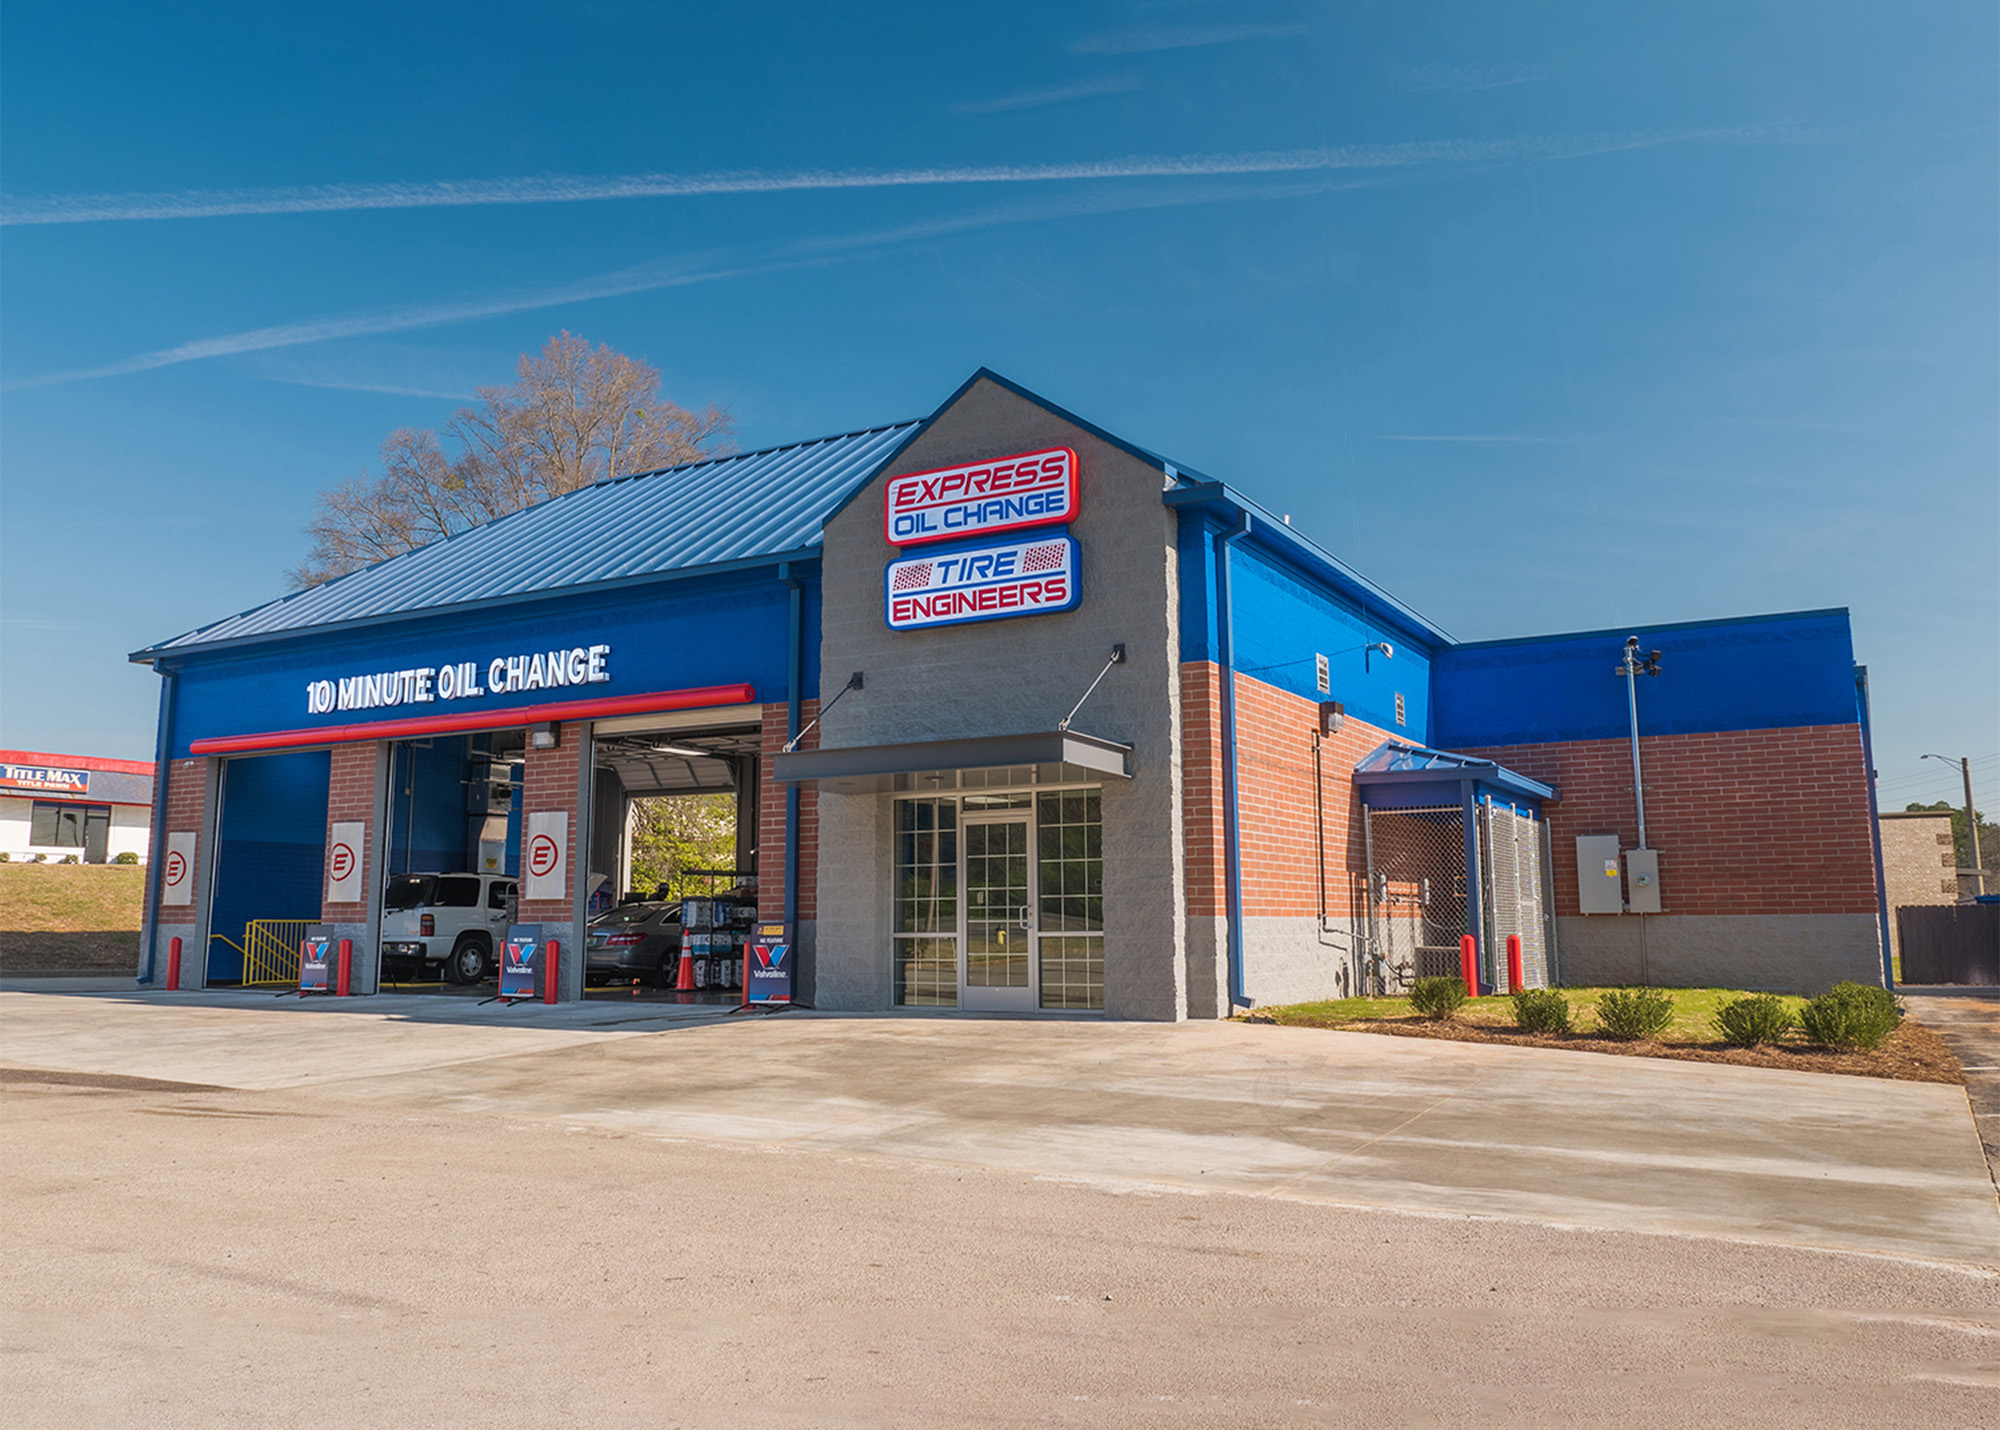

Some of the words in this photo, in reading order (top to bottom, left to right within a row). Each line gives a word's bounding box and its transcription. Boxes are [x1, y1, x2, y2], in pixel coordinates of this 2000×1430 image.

[894, 455, 1066, 507] EXPRESS
[894, 513, 937, 536] OIL
[944, 490, 1065, 529] CHANGE
[937, 551, 1018, 584] TIRE
[893, 578, 1067, 622] ENGINEERS
[306, 679, 336, 714] 10
[337, 667, 436, 711] MINUTE
[438, 662, 485, 699] OIL
[488, 644, 610, 694] CHANGE
[17, 780, 43, 788] TITLE
[44, 781, 70, 789] PAWN
[506, 966, 533, 974] Valvoline
[753, 969, 786, 978] Valvoline
